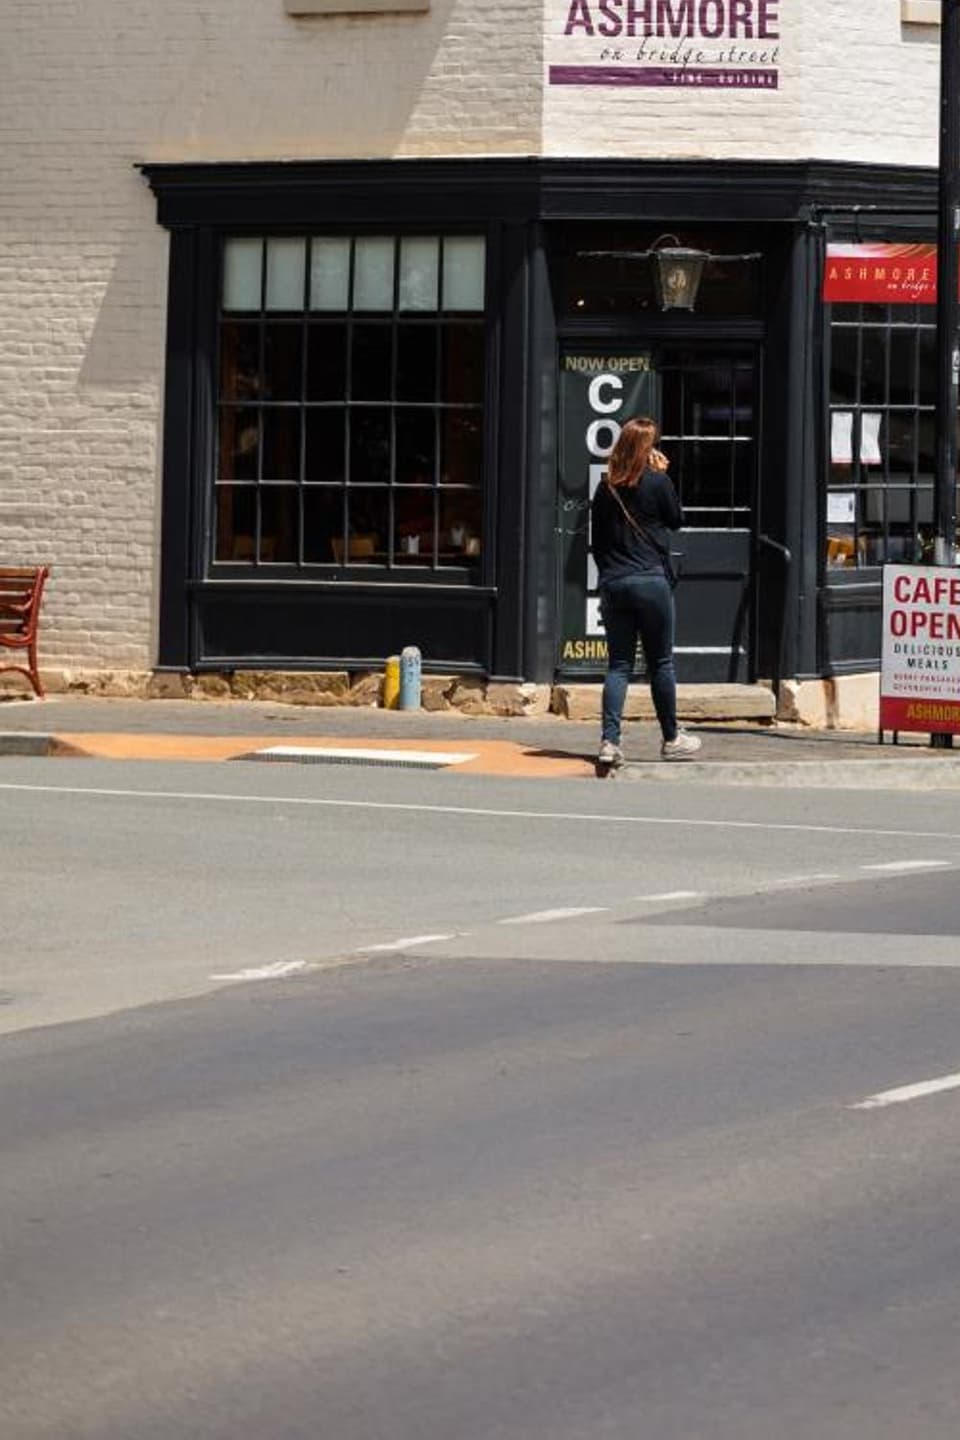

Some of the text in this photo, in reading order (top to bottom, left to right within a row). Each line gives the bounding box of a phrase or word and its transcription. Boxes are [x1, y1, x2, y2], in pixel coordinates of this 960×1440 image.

[636, 33, 704, 72] bridge
[719, 46, 778, 63] street
[829, 268, 930, 280] ASHMORE
[565, 356, 650, 372] NOW OPEN
[907, 658, 948, 671] MEALS
